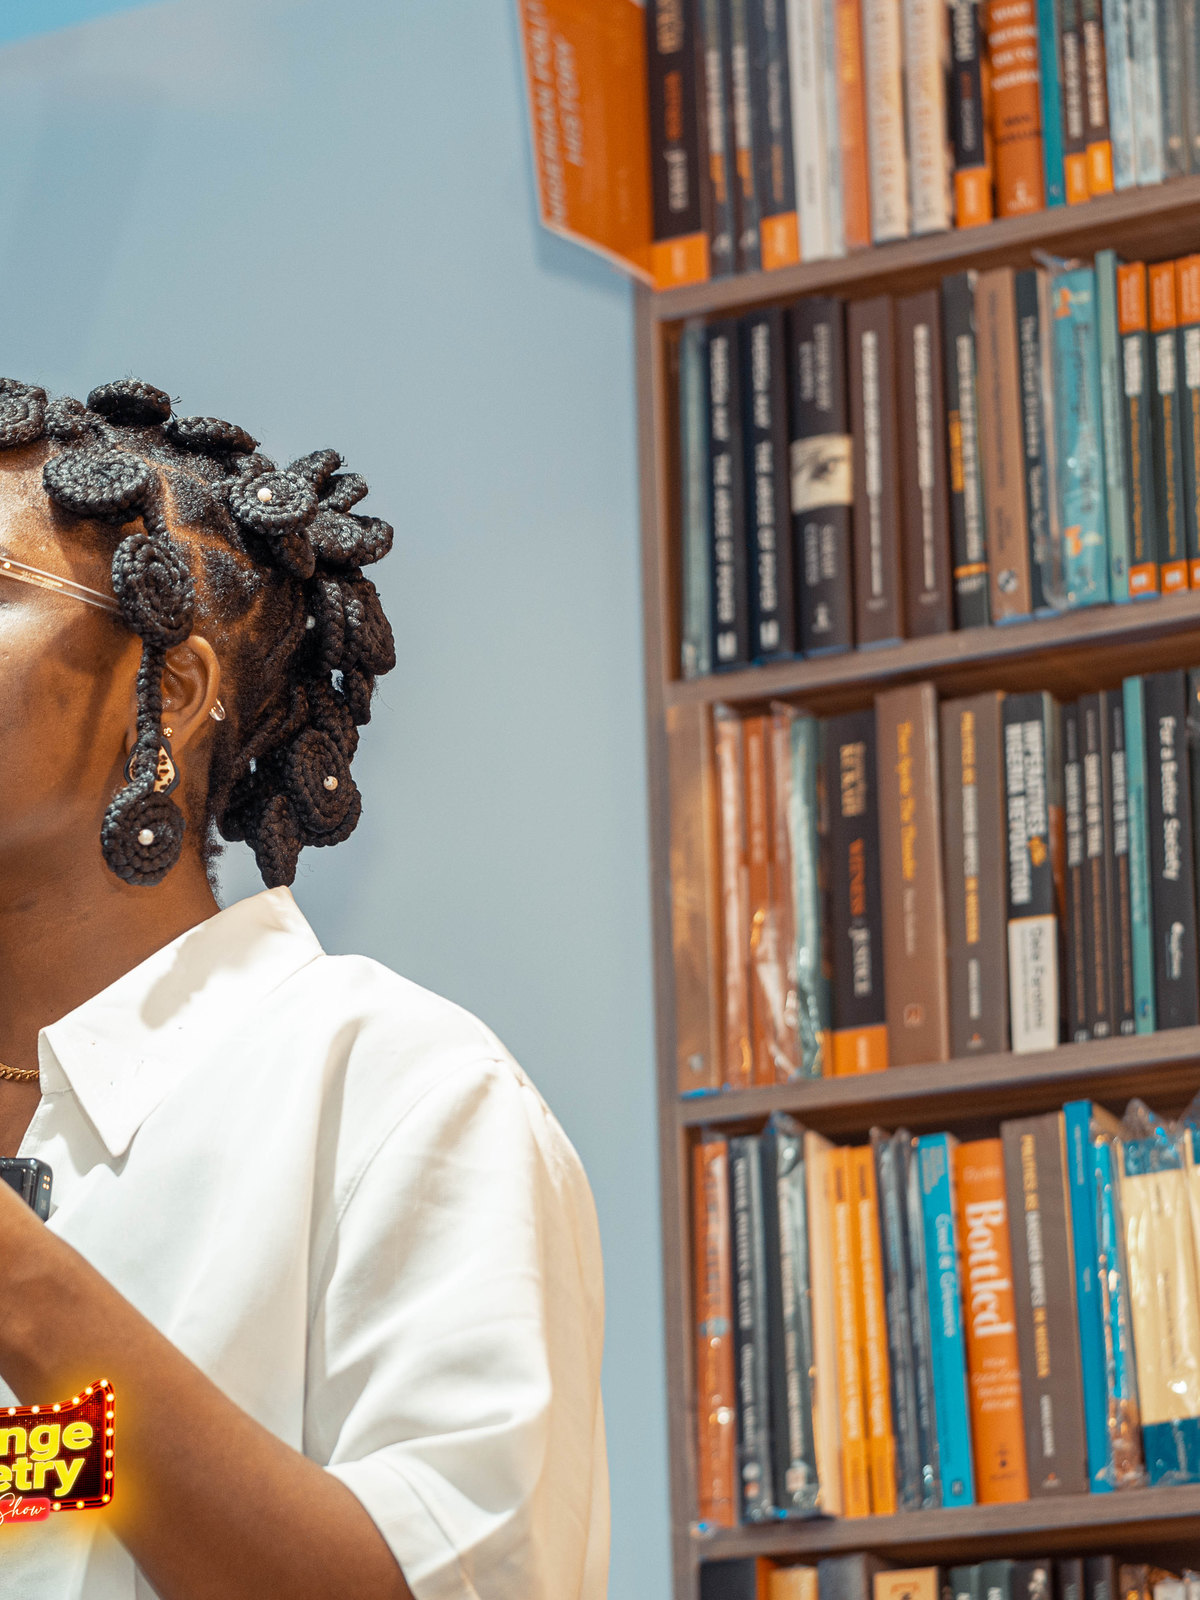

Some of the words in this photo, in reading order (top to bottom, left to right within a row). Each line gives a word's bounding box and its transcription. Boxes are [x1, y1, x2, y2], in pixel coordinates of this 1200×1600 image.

[1005, 723, 1024, 795] NIGERIA
[1159, 717, 1176, 745] For
[1161, 748, 1174, 760] a
[1161, 761, 1178, 814] Better
[1008, 797, 1031, 905] REVOLUTION
[1162, 818, 1181, 880] Society
[964, 1198, 1014, 1339] Bottled
